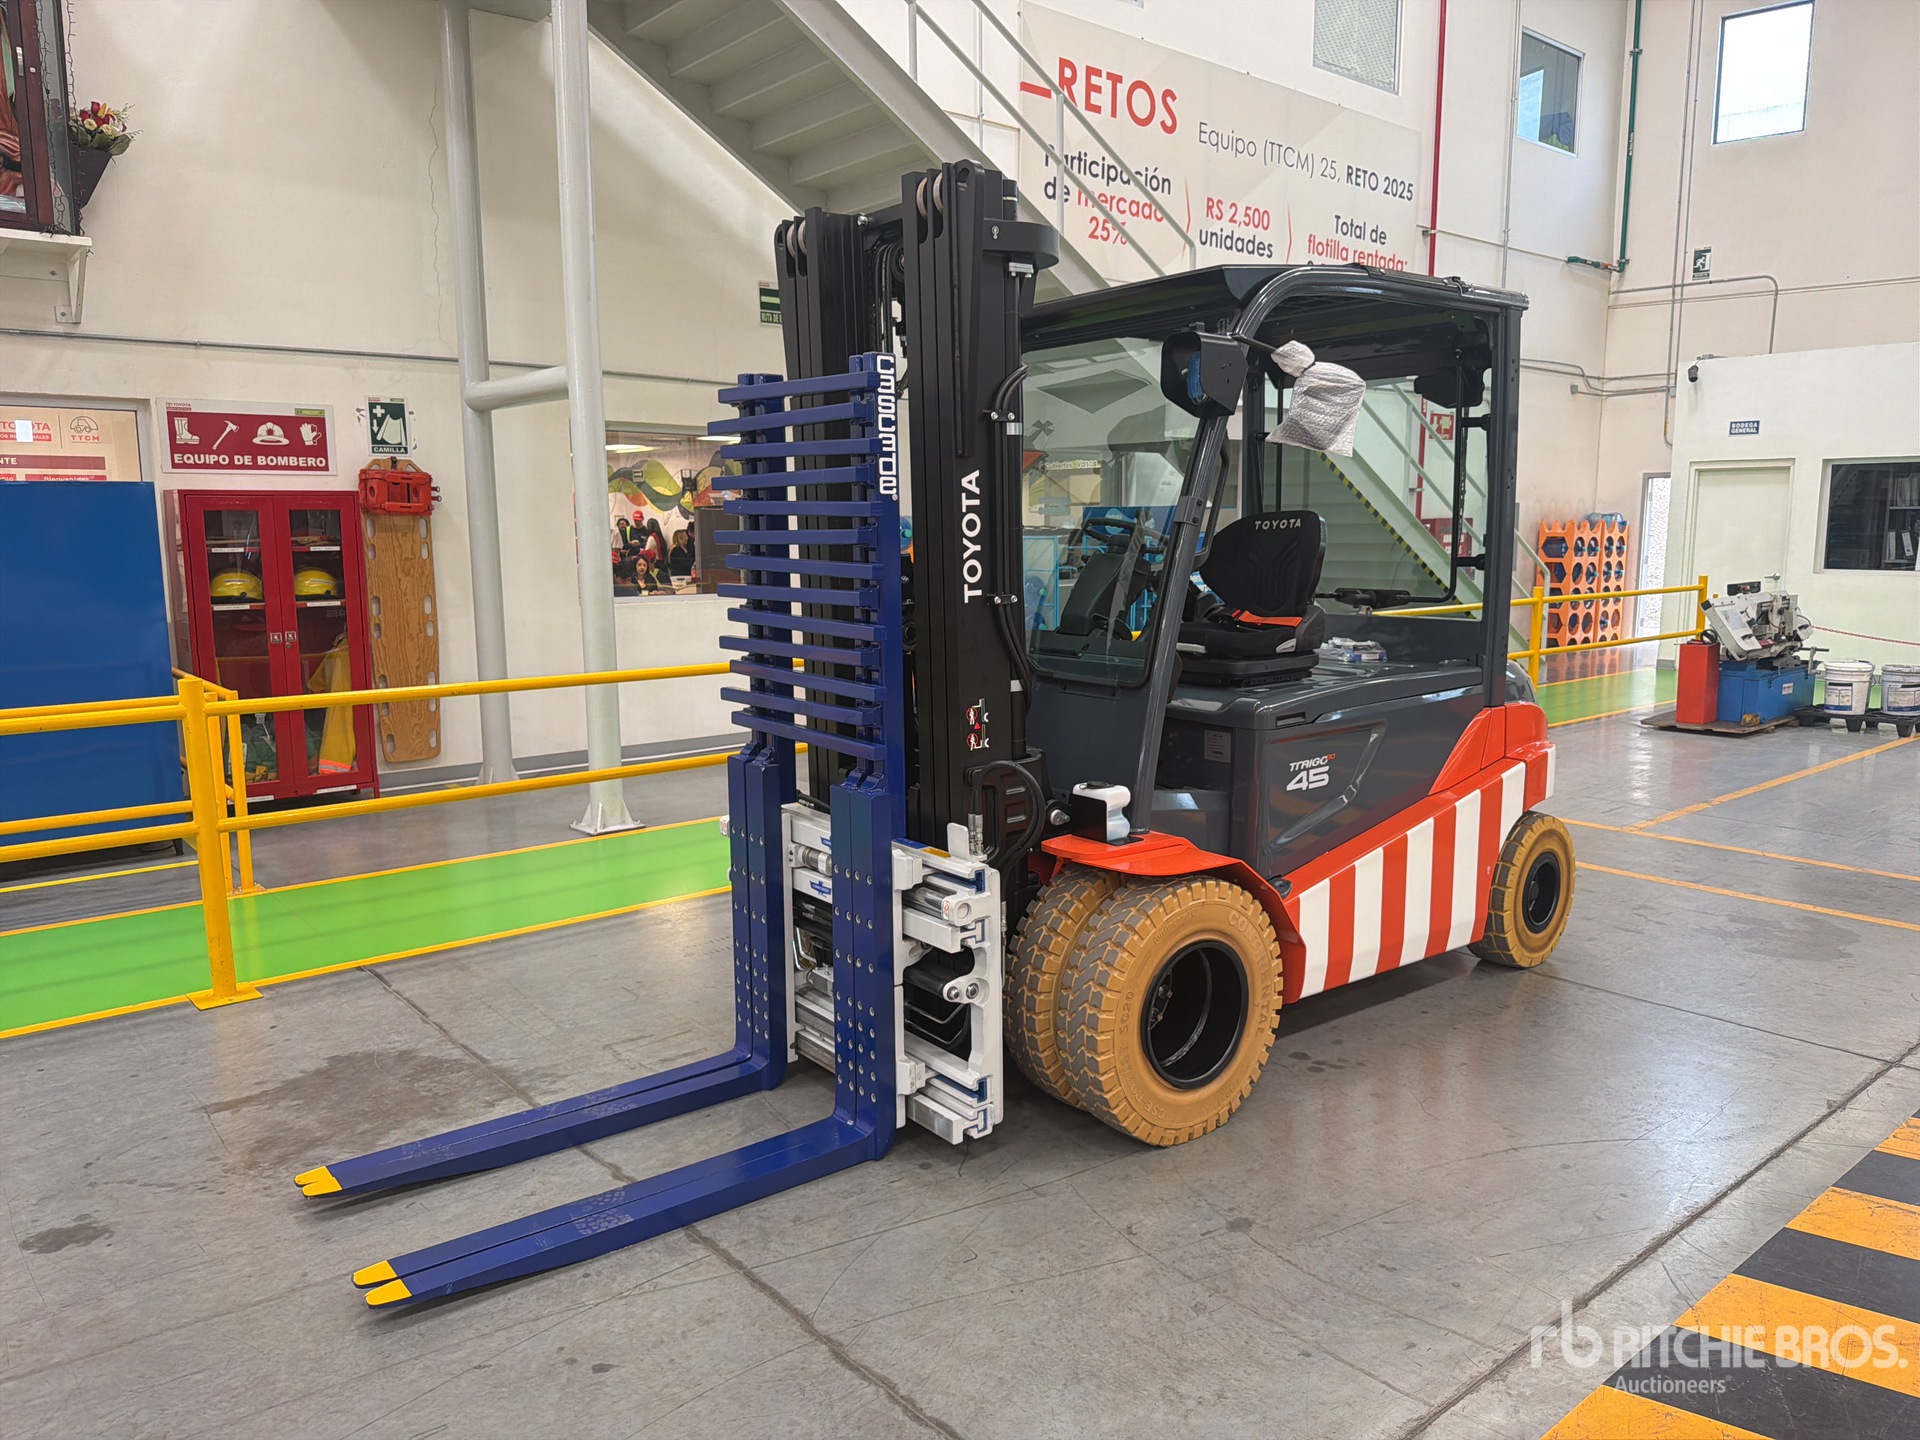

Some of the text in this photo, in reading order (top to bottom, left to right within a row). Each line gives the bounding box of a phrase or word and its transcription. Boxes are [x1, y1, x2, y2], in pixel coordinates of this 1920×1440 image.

[1058, 56, 1178, 135] RETOS
[1199, 122, 1414, 202] Equipo (TTCM) 25, RETO 2025
[1206, 196, 1271, 231] RS 2,500
[1199, 228, 1274, 259] unidades
[1335, 214, 1387, 245] Total de
[1307, 234, 1349, 262] flotilla
[70, 434, 100, 442] TTCM
[876, 355, 897, 495] CASCADE
[174, 453, 327, 468] EQUIPO DE BOMBERO
[961, 469, 983, 604] TOYOTA
[1254, 518, 1302, 530] TOYOTA
[1286, 765, 1330, 791] 45
[1119, 991, 1135, 1036] SC20
